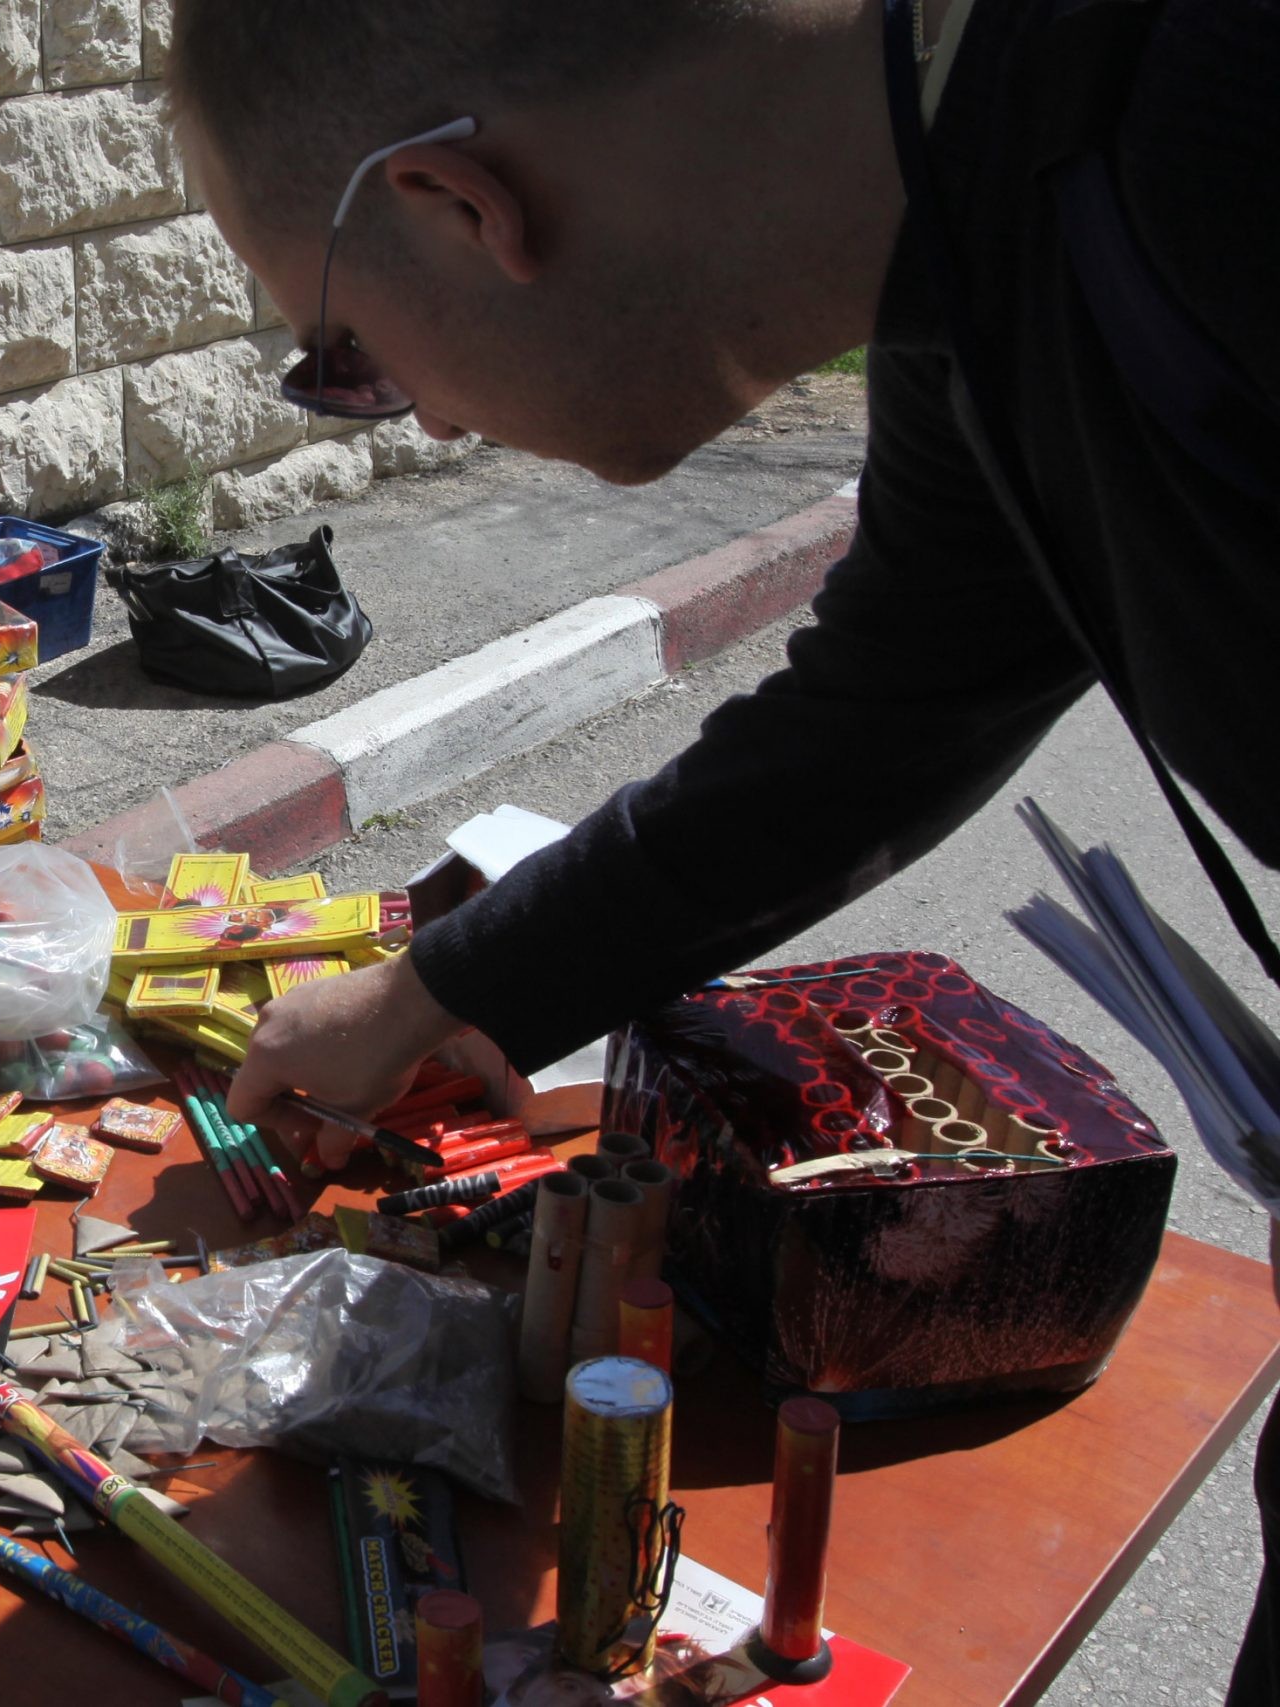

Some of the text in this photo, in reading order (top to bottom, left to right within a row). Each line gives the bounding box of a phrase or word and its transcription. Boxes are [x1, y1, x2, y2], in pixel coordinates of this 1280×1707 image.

[403, 1172, 487, 1209] K0204
[365, 1538, 397, 1674] MATCH CRACKER
